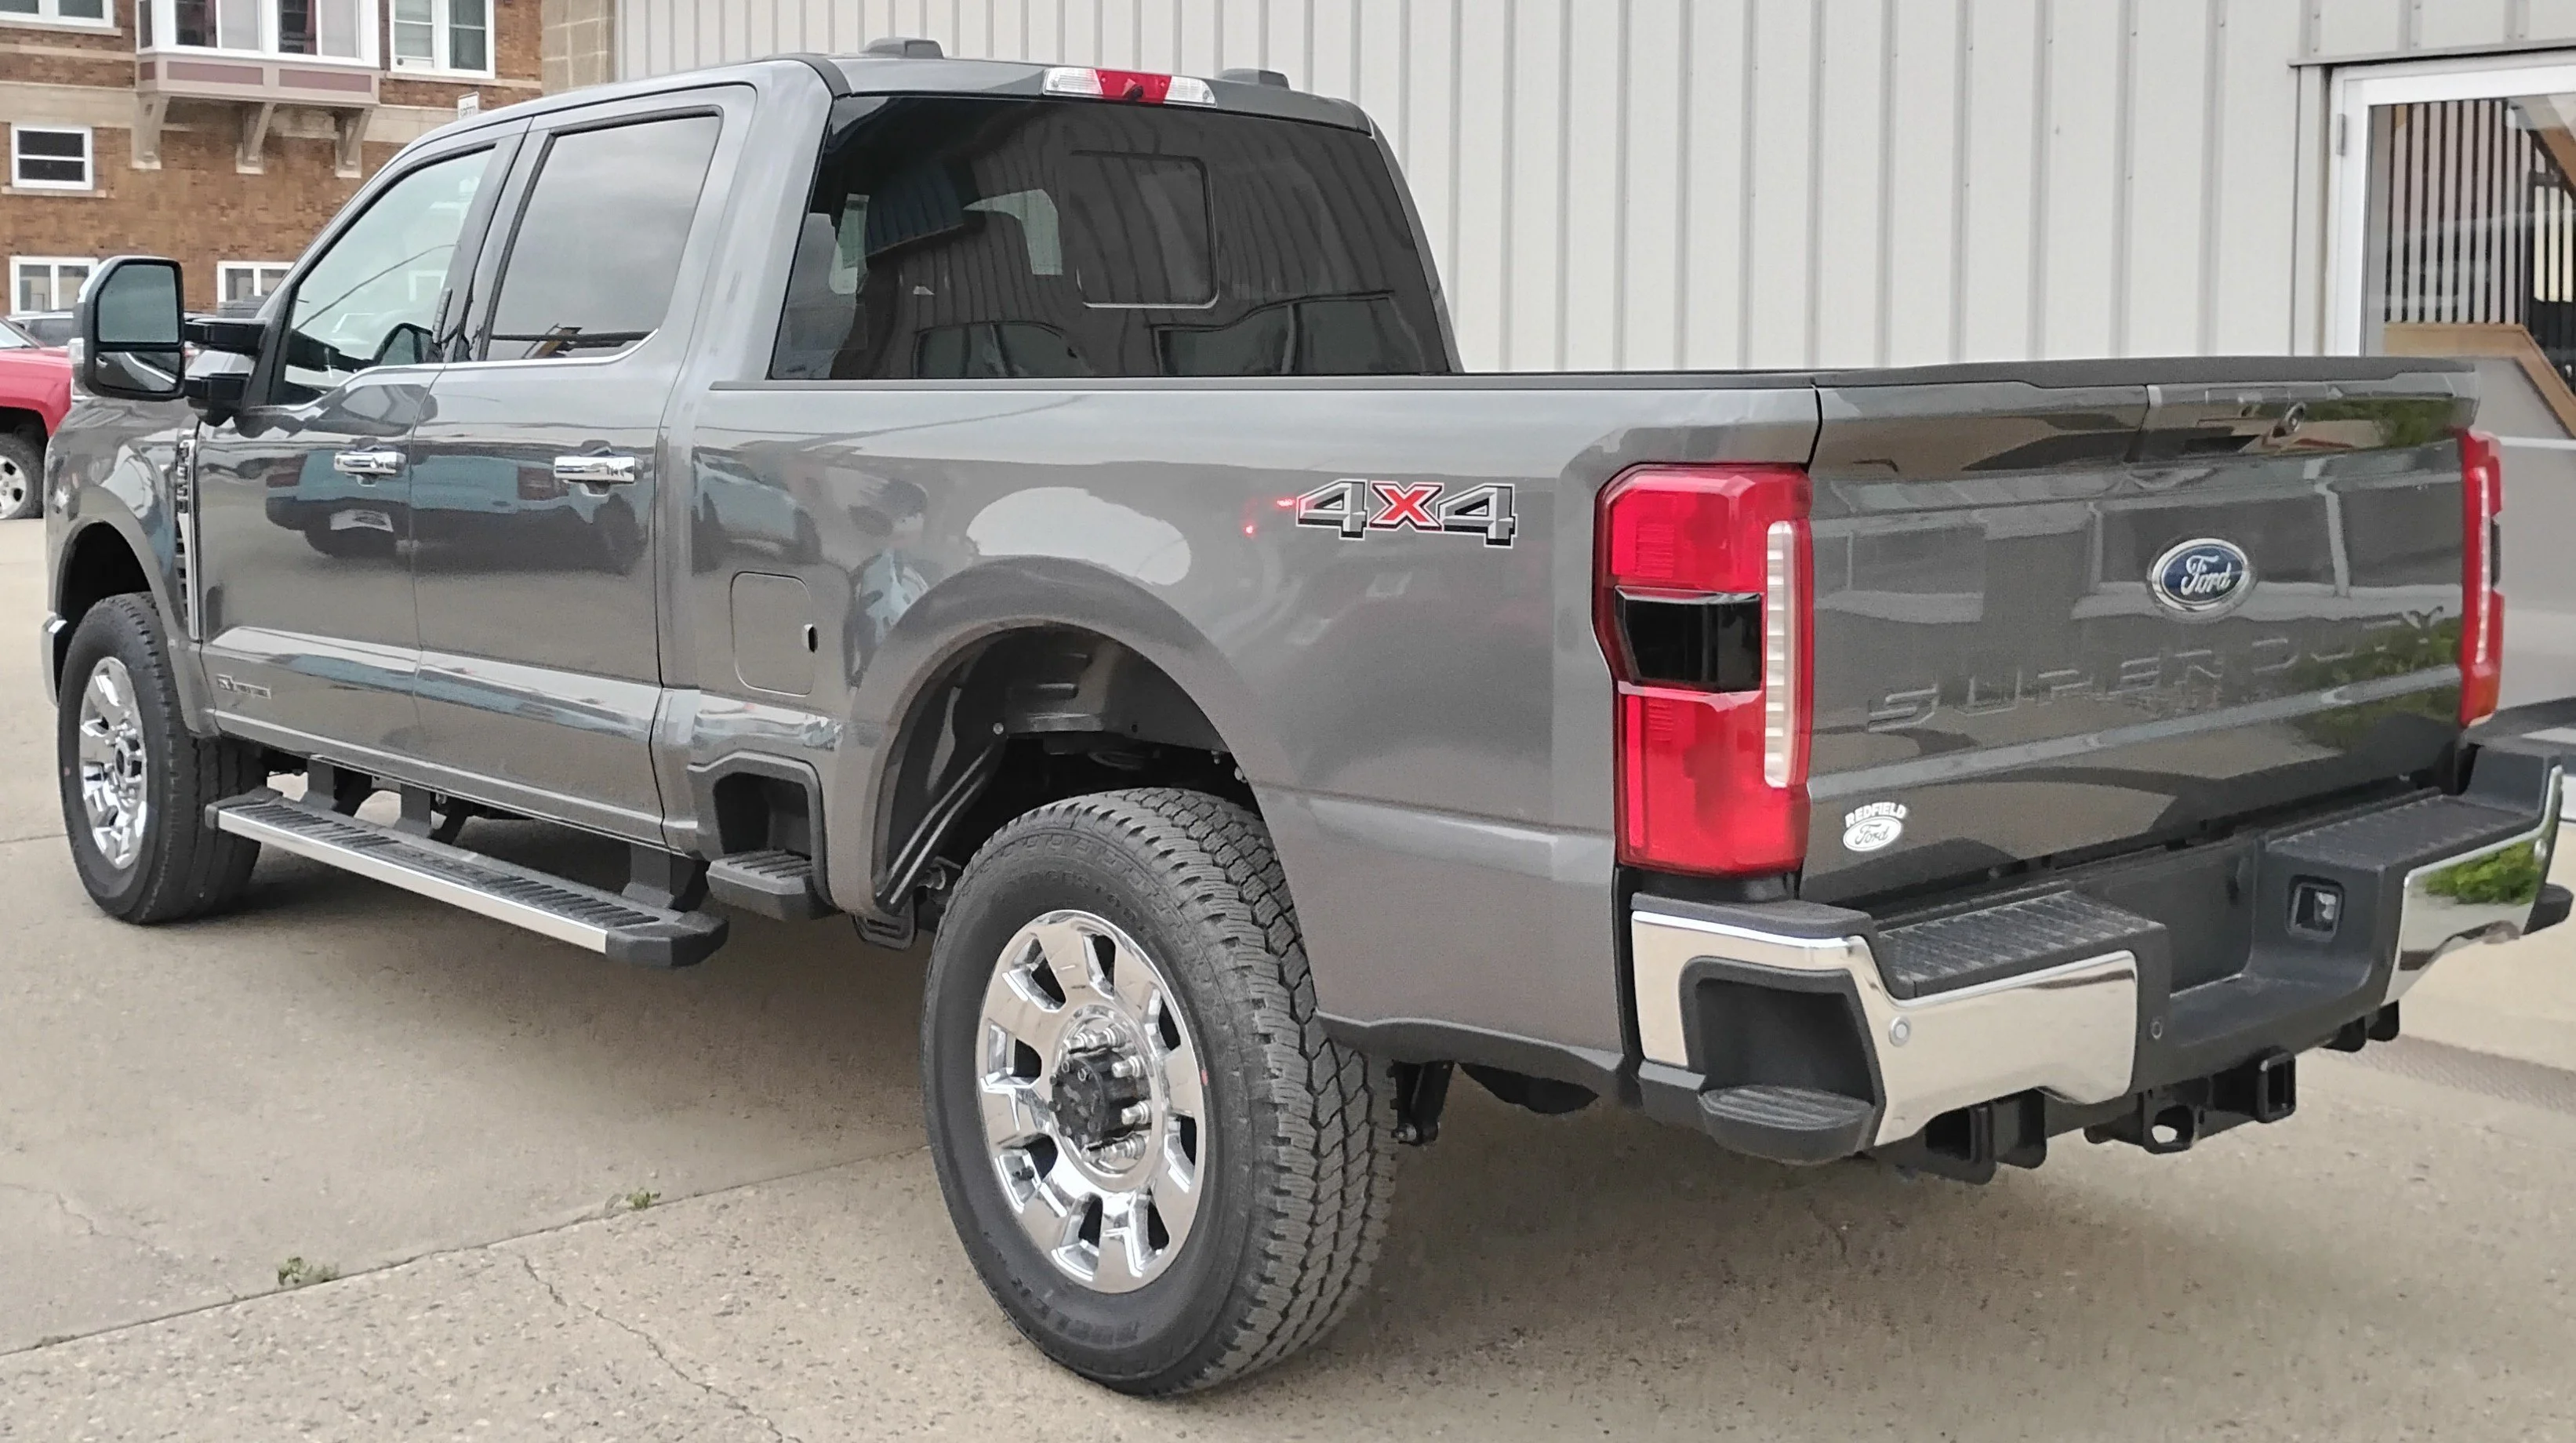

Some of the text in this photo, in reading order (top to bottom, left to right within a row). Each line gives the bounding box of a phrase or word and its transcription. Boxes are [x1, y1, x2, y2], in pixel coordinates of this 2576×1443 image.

[2181, 554, 2232, 596] Ford
[1866, 649, 2222, 734] SUPER
[1844, 801, 1907, 828] REDFIELD
[1855, 823, 1890, 845] Ford
